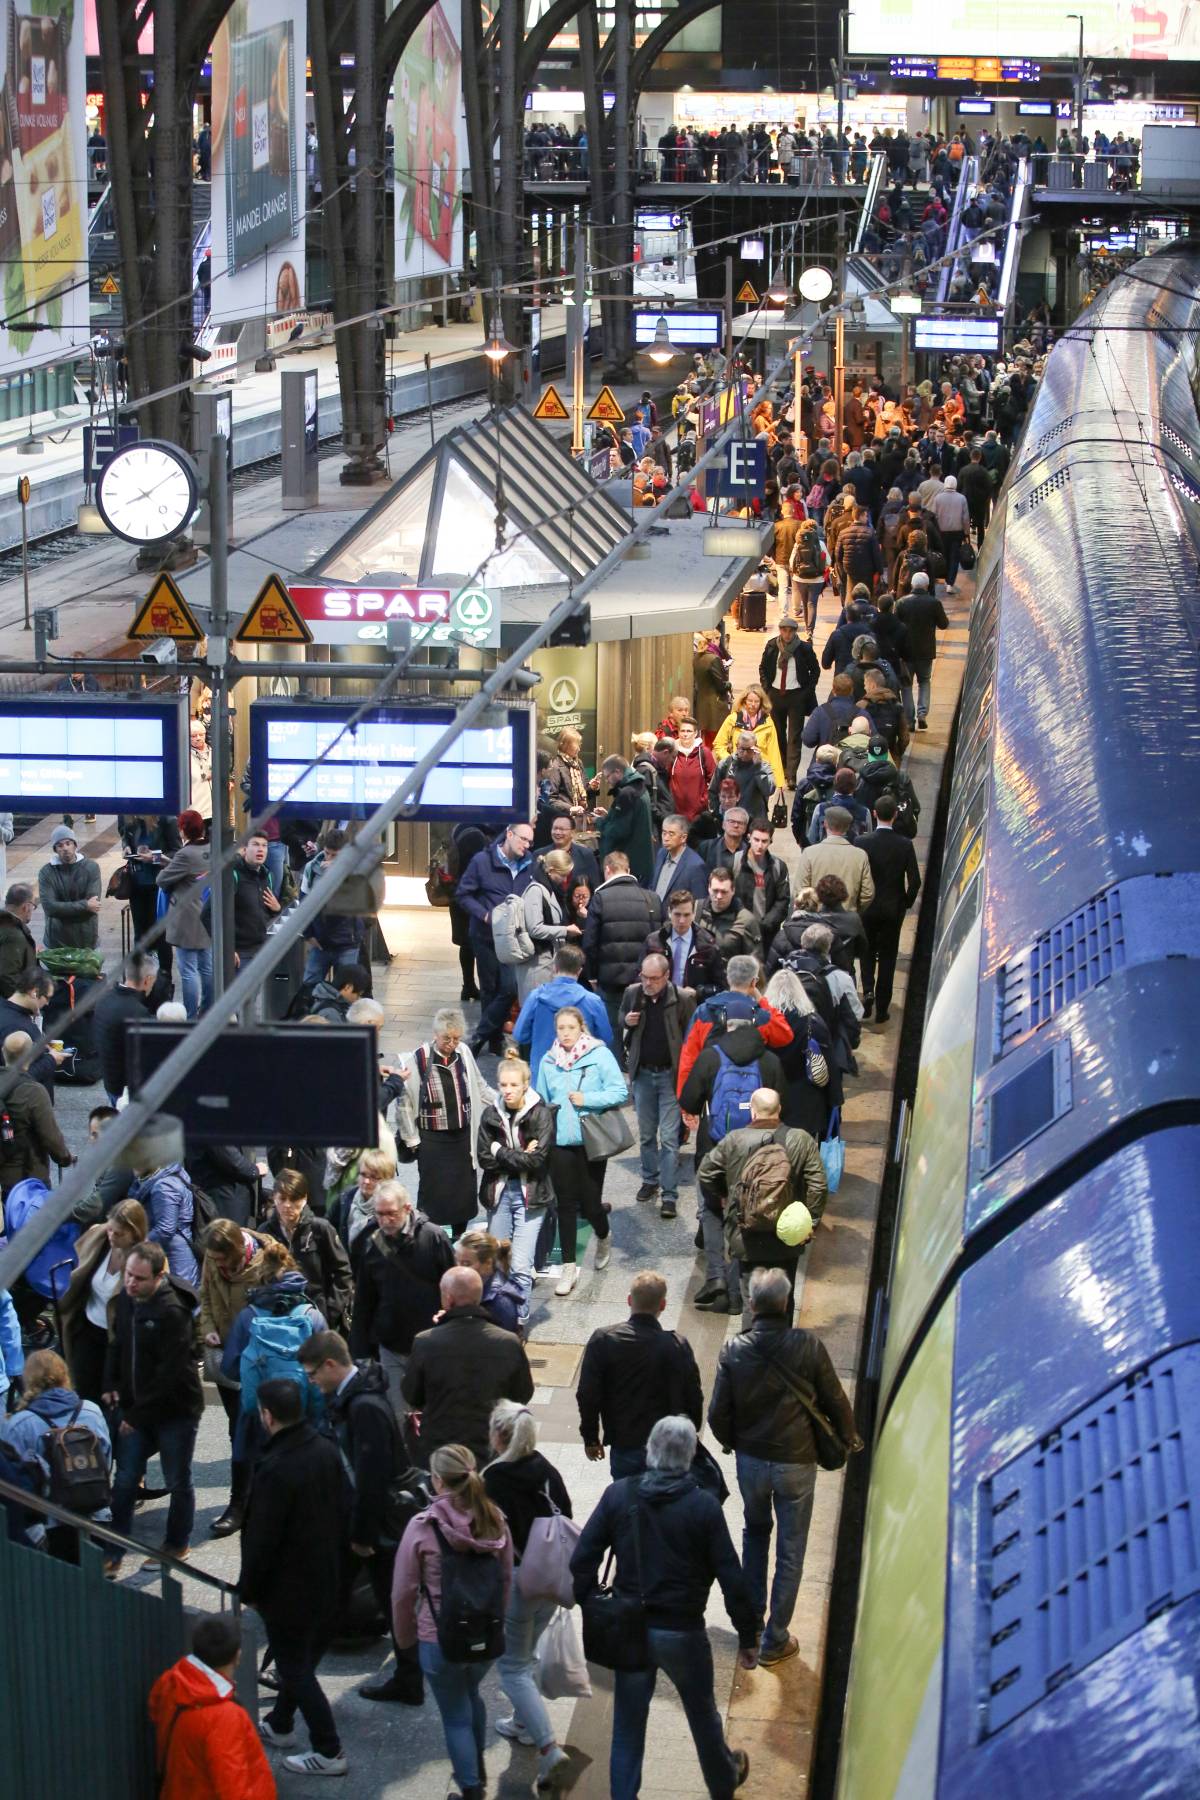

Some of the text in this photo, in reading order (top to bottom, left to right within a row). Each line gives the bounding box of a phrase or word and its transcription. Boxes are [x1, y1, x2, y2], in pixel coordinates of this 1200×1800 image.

[1056, 104, 1071, 116] 14
[235, 191, 287, 238] MANDEL ORANGE
[91, 430, 114, 470] E
[731, 442, 757, 485] E
[323, 592, 448, 618] SPAR
[549, 714, 581, 725] SPAR
[480, 727, 512, 752] 14
